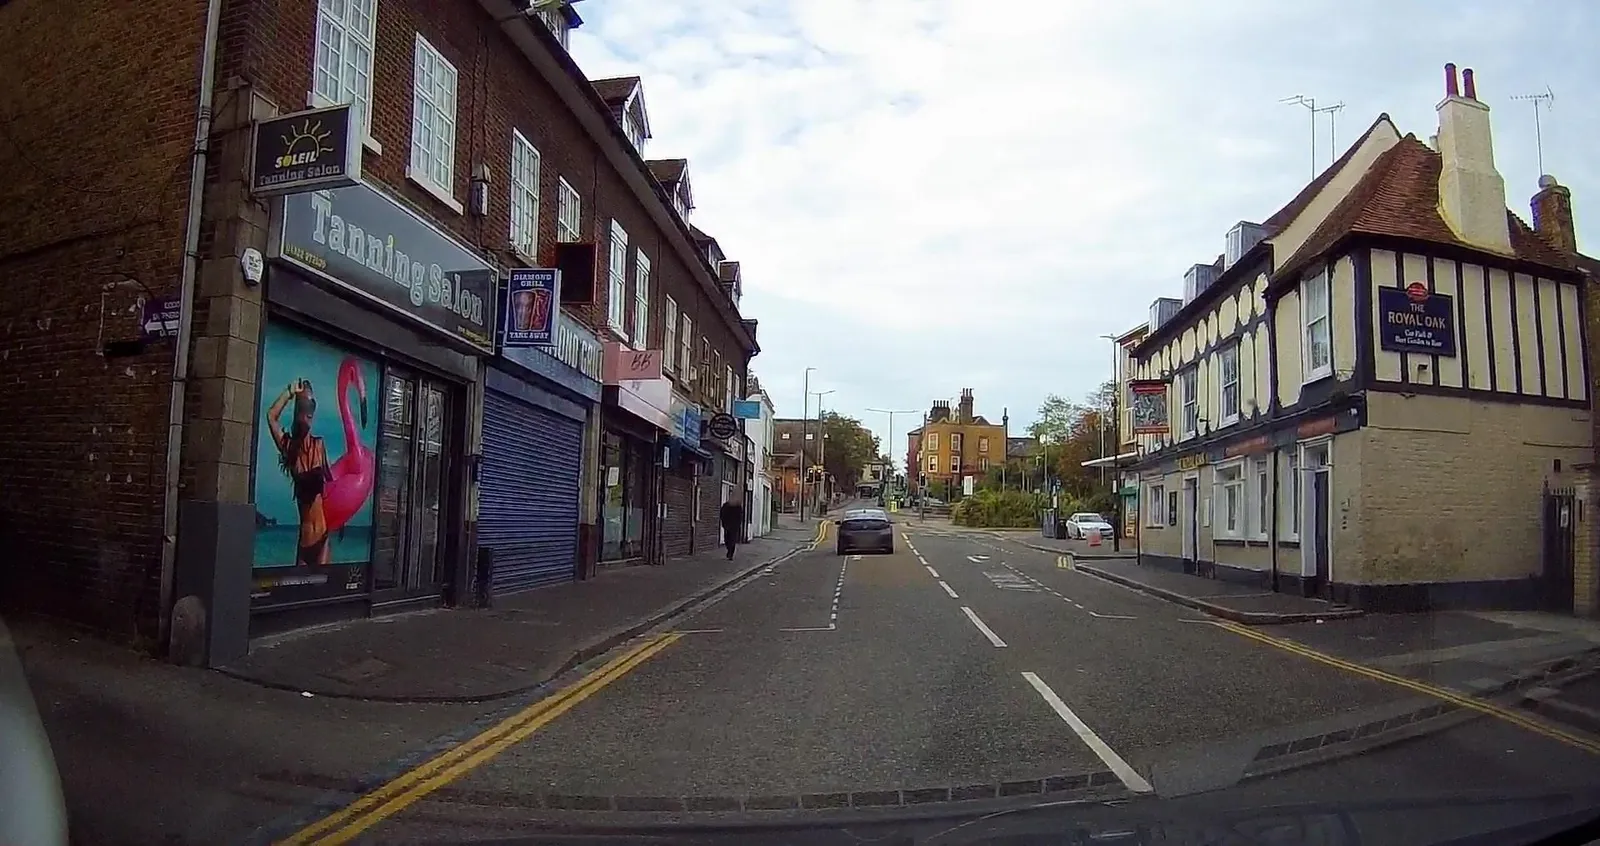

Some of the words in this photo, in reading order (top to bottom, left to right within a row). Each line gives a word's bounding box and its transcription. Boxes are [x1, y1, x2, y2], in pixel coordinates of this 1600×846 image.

[275, 150, 317, 168] SOLEIL
[260, 168, 304, 186] Tanning
[307, 164, 340, 178] Salon
[311, 191, 425, 306] Tanning
[428, 263, 483, 326] Salon
[1410, 303, 1425, 313] THE
[1388, 311, 1423, 326] ROYAL
[1425, 316, 1446, 329] OAK
[529, 331, 549, 339] AWAY
